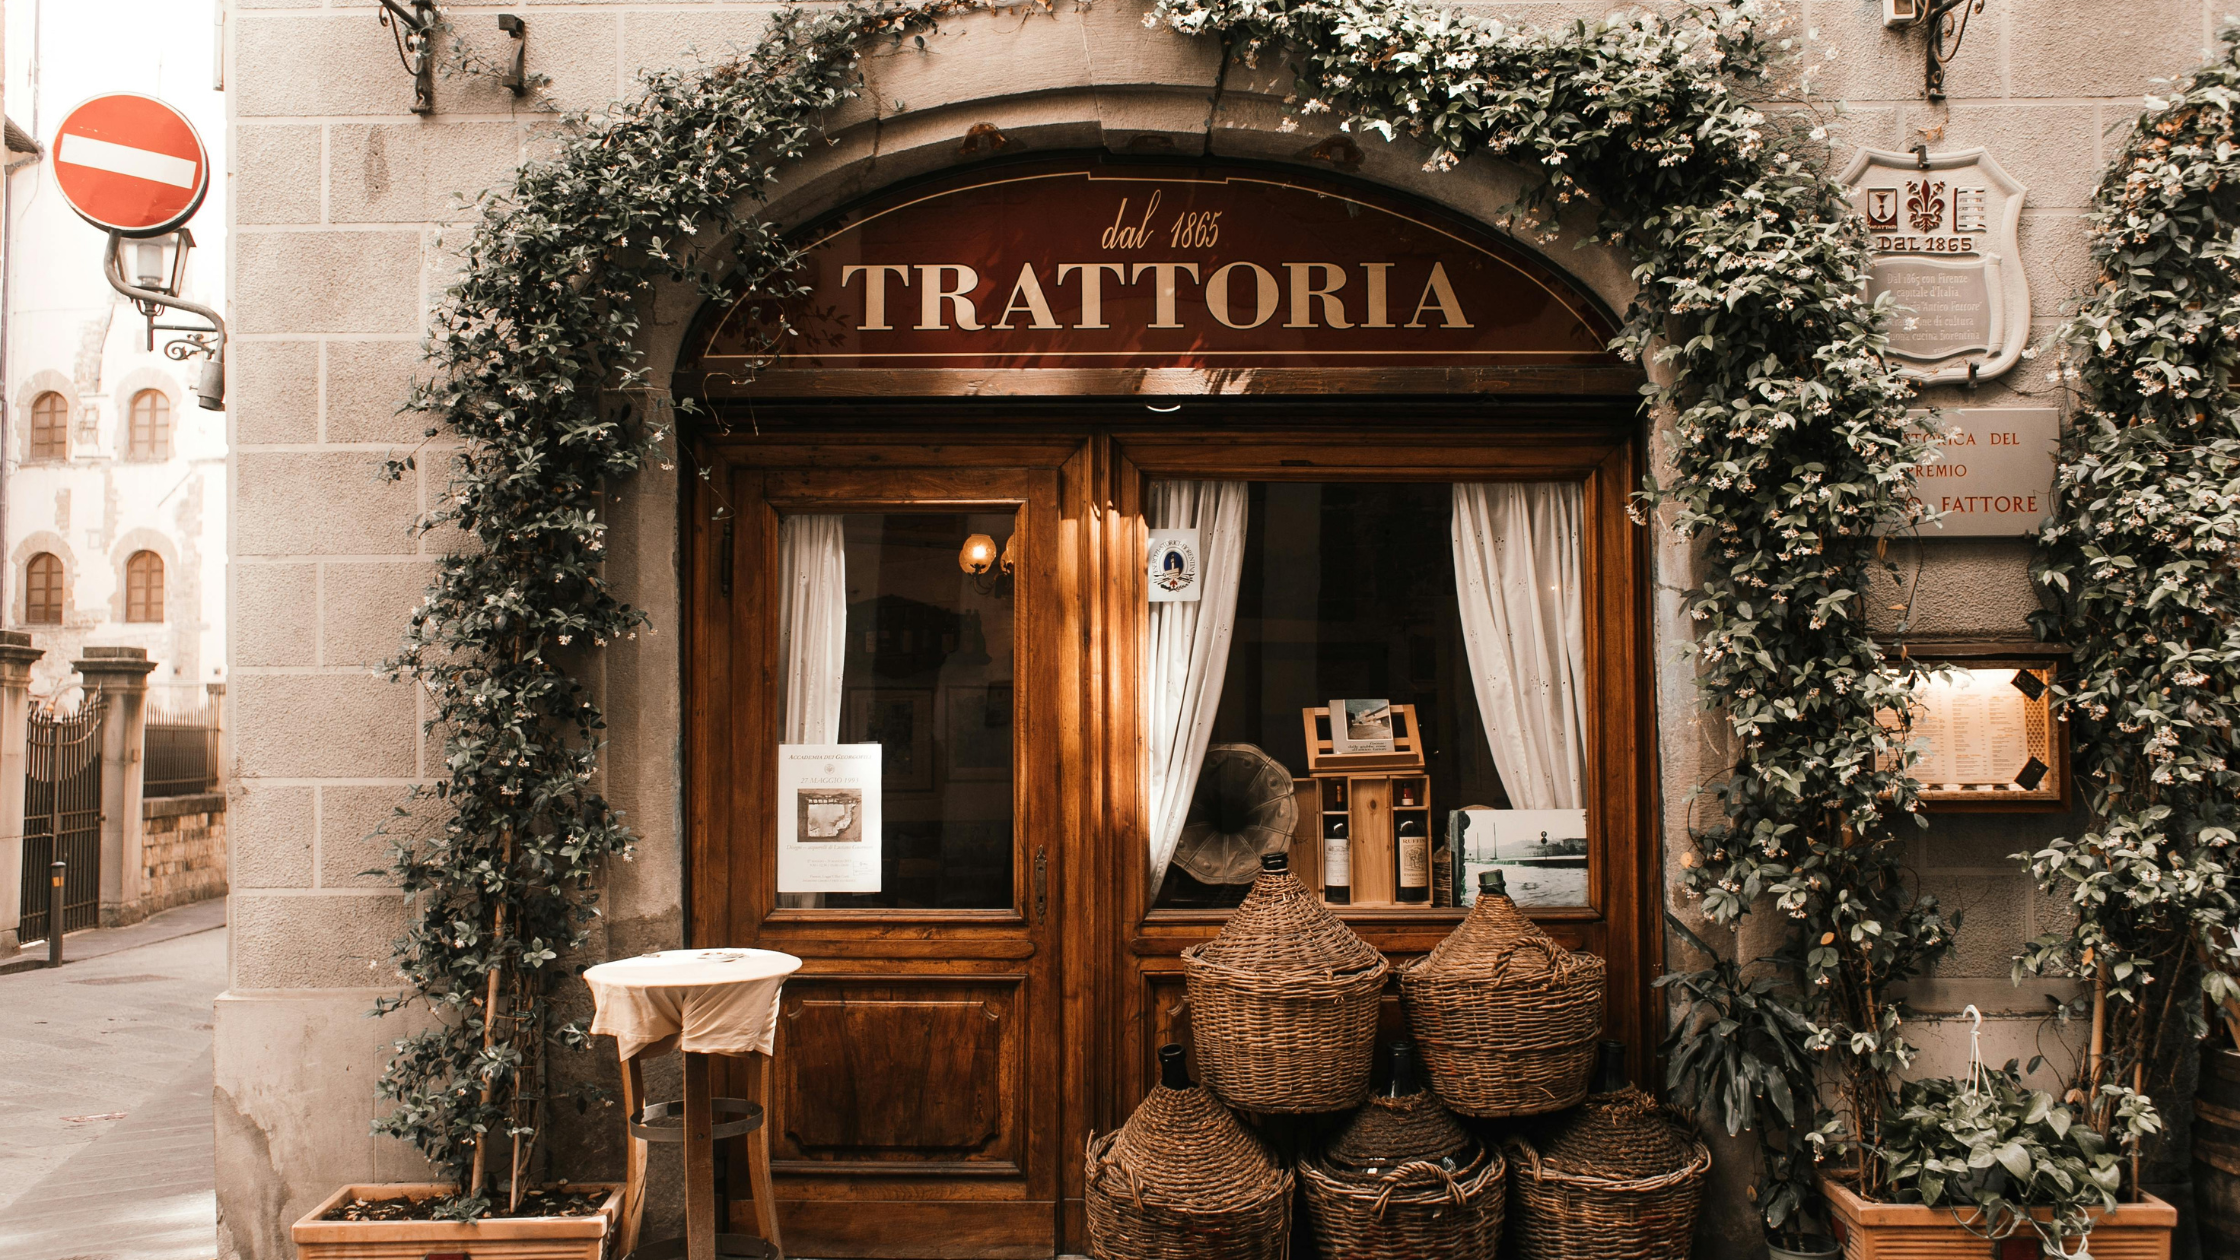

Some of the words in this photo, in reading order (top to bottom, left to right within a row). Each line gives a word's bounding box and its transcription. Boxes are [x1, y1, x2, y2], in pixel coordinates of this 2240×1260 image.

[1101, 189, 1161, 250] dal
[1170, 210, 1220, 249] 1865
[1925, 236, 1972, 251] 1865
[1888, 272, 1900, 284] Dal
[1903, 272, 1920, 286] 1865
[1922, 275, 1935, 284] con
[1938, 272, 1968, 284] Firenze
[841, 261, 1475, 331] TRATTORIA
[1896, 286, 1928, 300] capitale
[1934, 315, 1942, 326] di
[1944, 316, 1974, 326] cultura
[1890, 331, 1910, 341] uona
[1912, 330, 1938, 341] cucina
[1940, 330, 1980, 340] fiorentina
[1990, 433, 2020, 445] DEL
[1942, 496, 2038, 513] FATTORE
